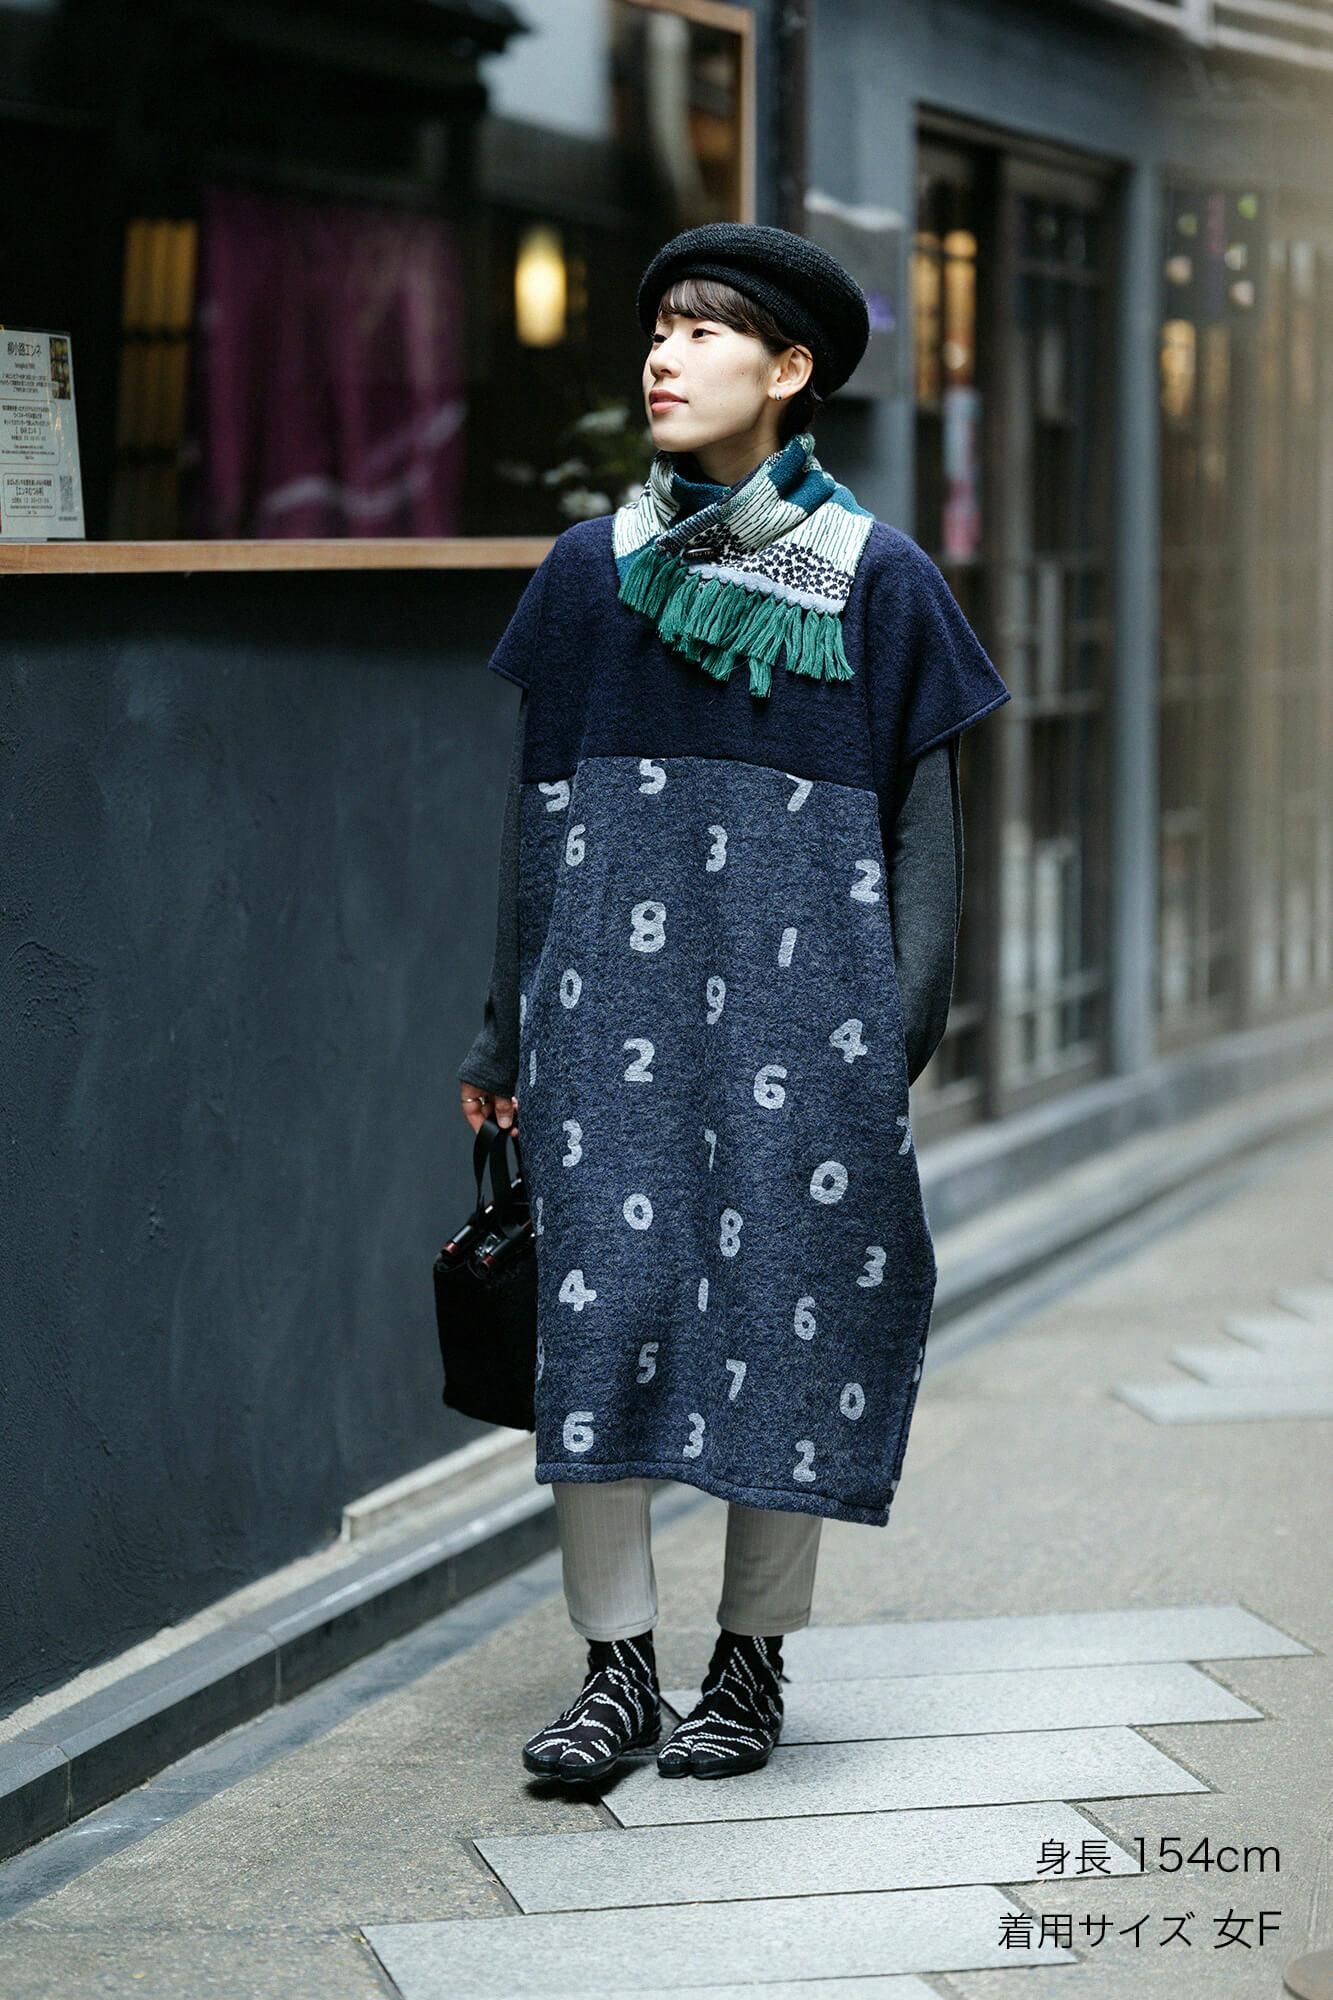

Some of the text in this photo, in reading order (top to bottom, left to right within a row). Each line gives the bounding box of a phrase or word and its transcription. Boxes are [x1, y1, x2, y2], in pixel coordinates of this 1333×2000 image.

[638, 758, 667, 794] 5
[786, 773, 813, 812] 7
[565, 824, 586, 867] 6
[705, 825, 728, 872] 3
[850, 859, 881, 904] 2
[629, 900, 667, 953] 8
[777, 927, 798, 967] 1
[559, 968, 583, 1009] 0
[706, 976, 726, 1025] 9
[623, 1038, 656, 1083] 2
[829, 1018, 868, 1064] 4
[753, 1064, 788, 1110] 6
[562, 1119, 583, 1167] 3
[809, 1160, 848, 1205] 0
[623, 1193, 654, 1231] 0
[719, 1208, 744, 1257] 8
[856, 1246, 887, 1288] 3
[558, 1269, 597, 1312] 4
[698, 1277, 709, 1312] 1
[793, 1296, 816, 1341] 6
[636, 1341, 659, 1384] 5
[725, 1359, 747, 1400] 7
[839, 1383, 866, 1420] 0
[562, 1410, 594, 1453] 6
[682, 1412, 706, 1458] 3
[793, 1440, 816, 1482] 2
